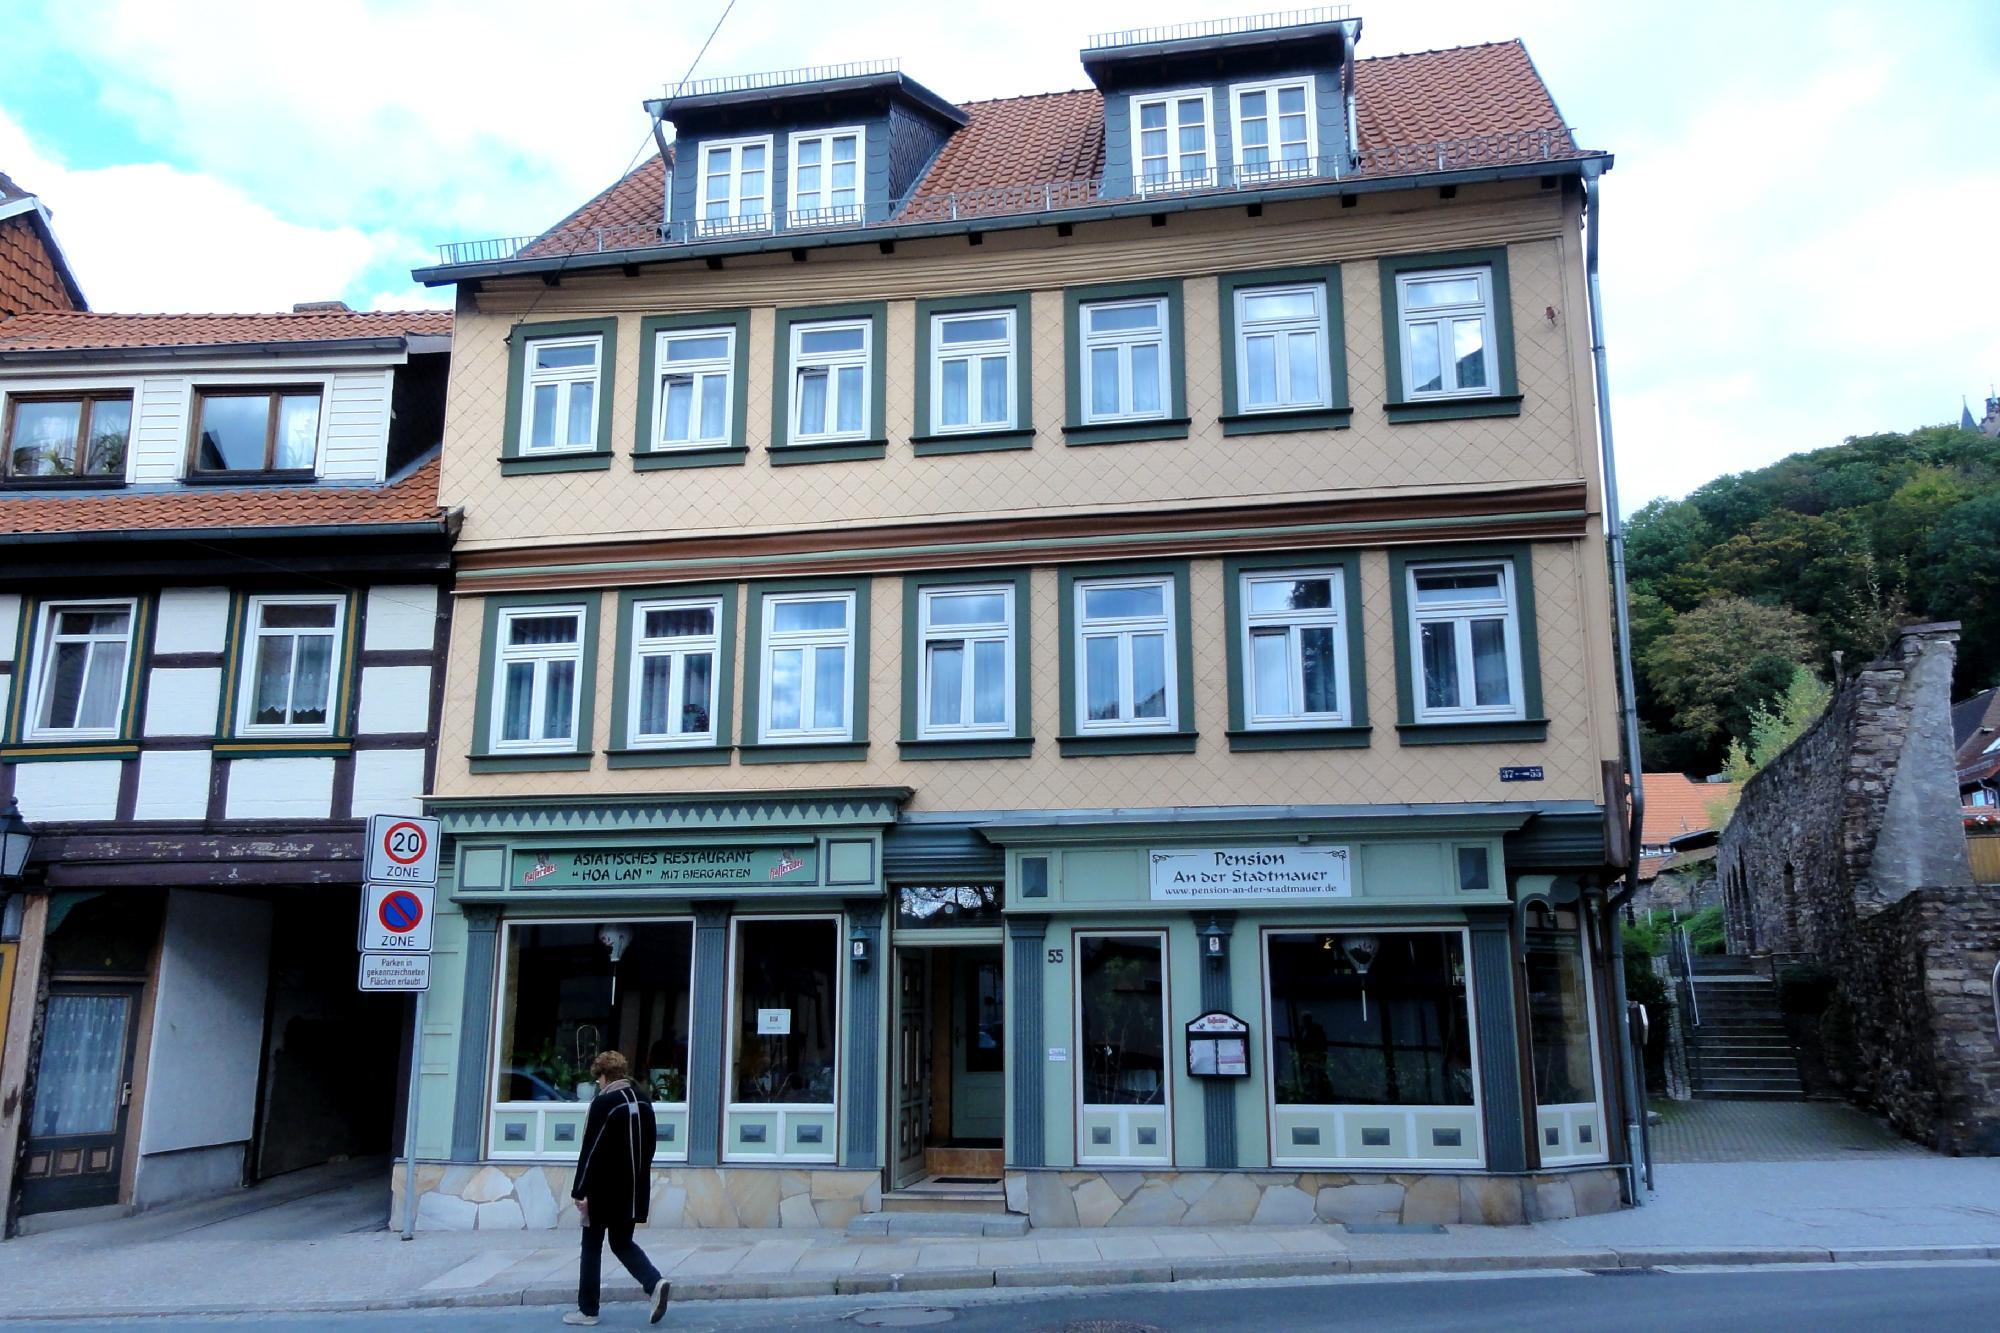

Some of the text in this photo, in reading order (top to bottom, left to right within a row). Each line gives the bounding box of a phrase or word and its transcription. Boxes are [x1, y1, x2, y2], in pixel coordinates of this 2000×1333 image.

[392, 832, 420, 853] 20
[573, 849, 756, 866] ASIATISCHES RESTAURANT
[1213, 851, 1285, 867] Pension
[386, 865, 420, 878] ZONE
[660, 869, 679, 880] MIT
[683, 868, 751, 880] BIERGARTEN
[1173, 869, 1327, 884] An der Stadtmauer
[1165, 884, 1337, 896] www.pension-an-der-stadtmauer.de
[381, 935, 415, 947] ZONE
[1047, 949, 1064, 963] 55
[381, 958, 413, 967] Parken in
[366, 968, 425, 978] gekennzeichneten
[370, 976, 421, 986] Flächen erlaubt
